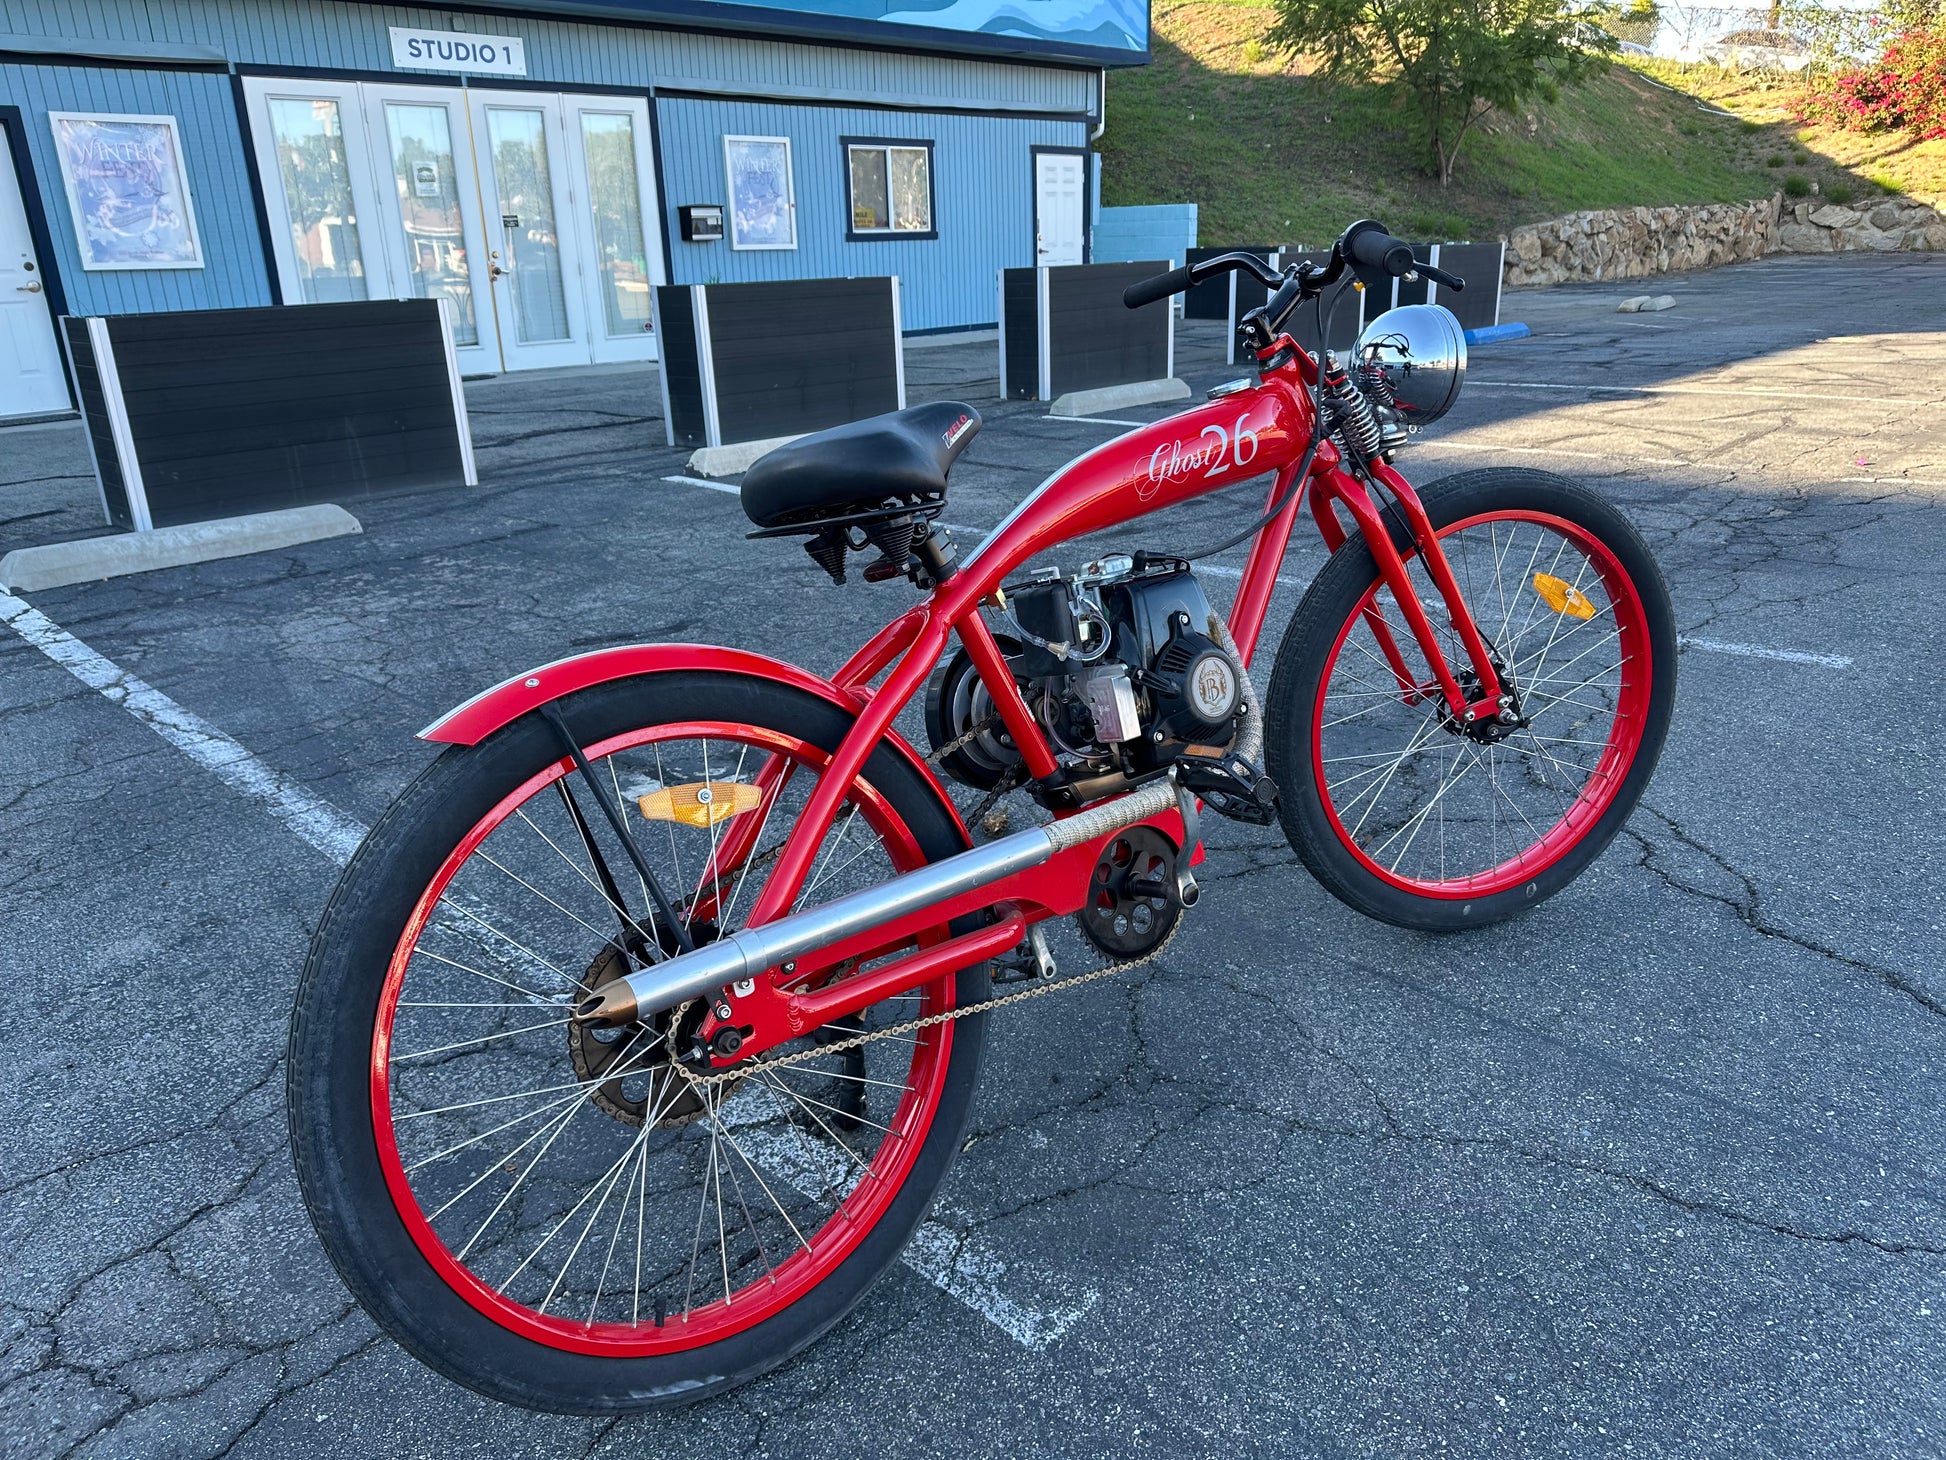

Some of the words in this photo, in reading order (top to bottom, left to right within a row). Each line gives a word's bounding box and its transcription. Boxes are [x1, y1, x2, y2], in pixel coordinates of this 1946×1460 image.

[407, 38, 496, 63] STUDIO
[502, 46, 511, 65] 1
[71, 138, 167, 165] WINTER
[735, 156, 782, 175] WINTER
[747, 171, 773, 186] FEST
[947, 414, 968, 437] VELO
[1133, 440, 1216, 501] Ghost
[1200, 413, 1258, 478] 26
